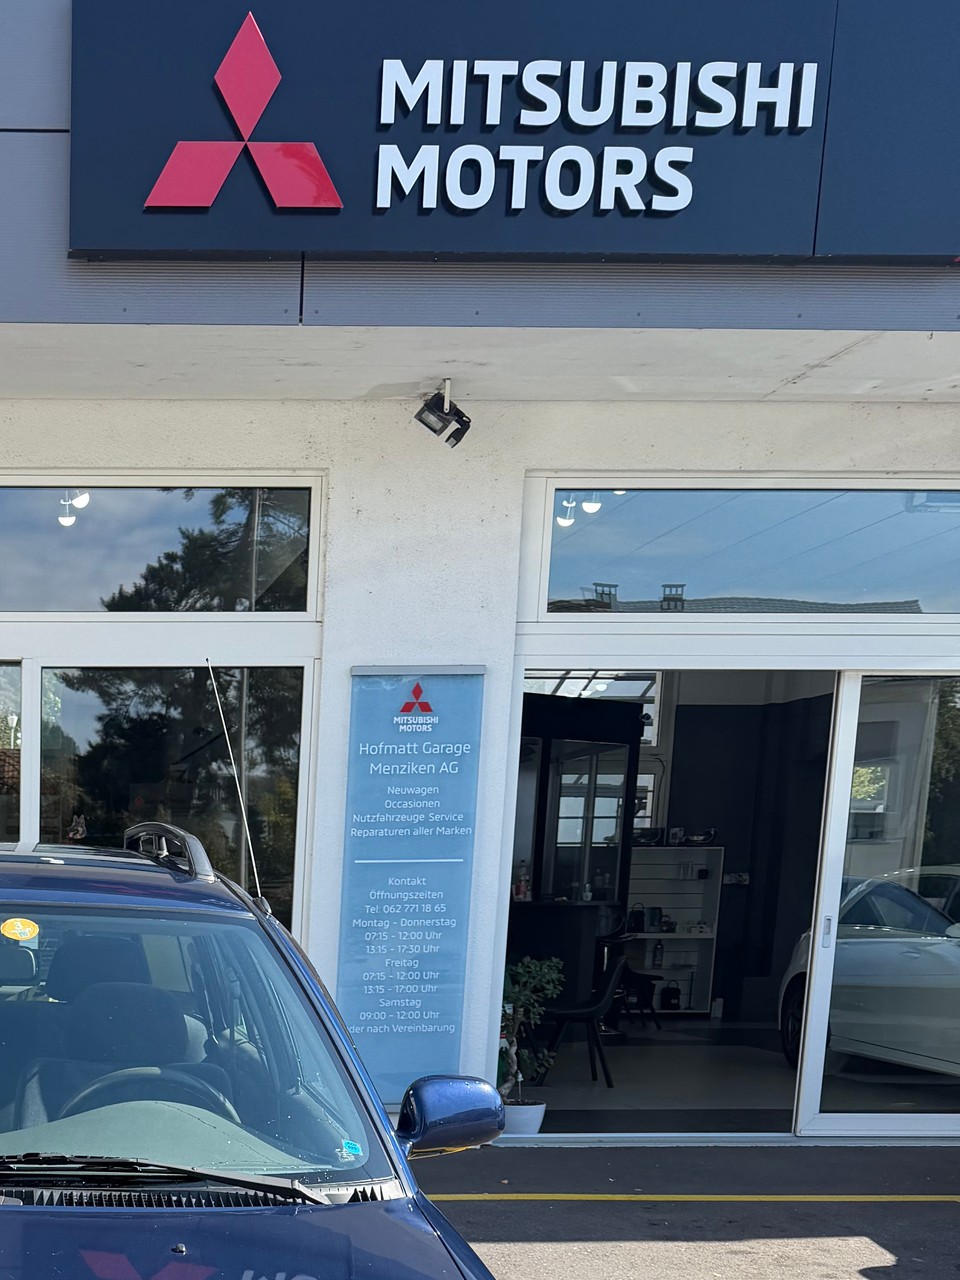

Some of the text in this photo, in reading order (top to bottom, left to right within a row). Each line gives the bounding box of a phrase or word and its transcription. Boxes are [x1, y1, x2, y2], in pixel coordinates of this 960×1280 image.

[380, 59, 817, 128] MITSUBISHI
[376, 144, 693, 212] MOTORS
[360, 742, 471, 756] Hofmatt Garage
[370, 762, 459, 774] Menziken AG
[387, 786, 439, 796] Neuwagen
[385, 800, 440, 808] Occasionen
[353, 813, 463, 823] Nutzfahrzeuge Service
[351, 827, 472, 838] Reparaturen aller Marken
[388, 878, 426, 886] Kontakt
[370, 889, 443, 901] Öffnungszeiten
[383, 905, 401, 913] 062
[422, 904, 431, 912] 18
[435, 904, 446, 912] 65
[353, 919, 389, 928] Montag
[400, 918, 456, 927] Donnerstag
[365, 932, 388, 940] 07:15
[398, 932, 422, 940] 12:00
[425, 931, 442, 939] Uhr
[398, 945, 420, 953] 17:30
[423, 945, 440, 953] Uhr
[385, 959, 419, 968] Freitag
[363, 972, 386, 980] 07:15
[396, 972, 420, 980] 12:00
[395, 985, 418, 993] 17:00
[379, 999, 421, 1008] Samstag
[360, 1012, 386, 1020] 09:00
[396, 1011, 420, 1019] 12:00
[423, 1011, 440, 1019] Uhr
[349, 1024, 455, 1033] der nach Vereinbarung
